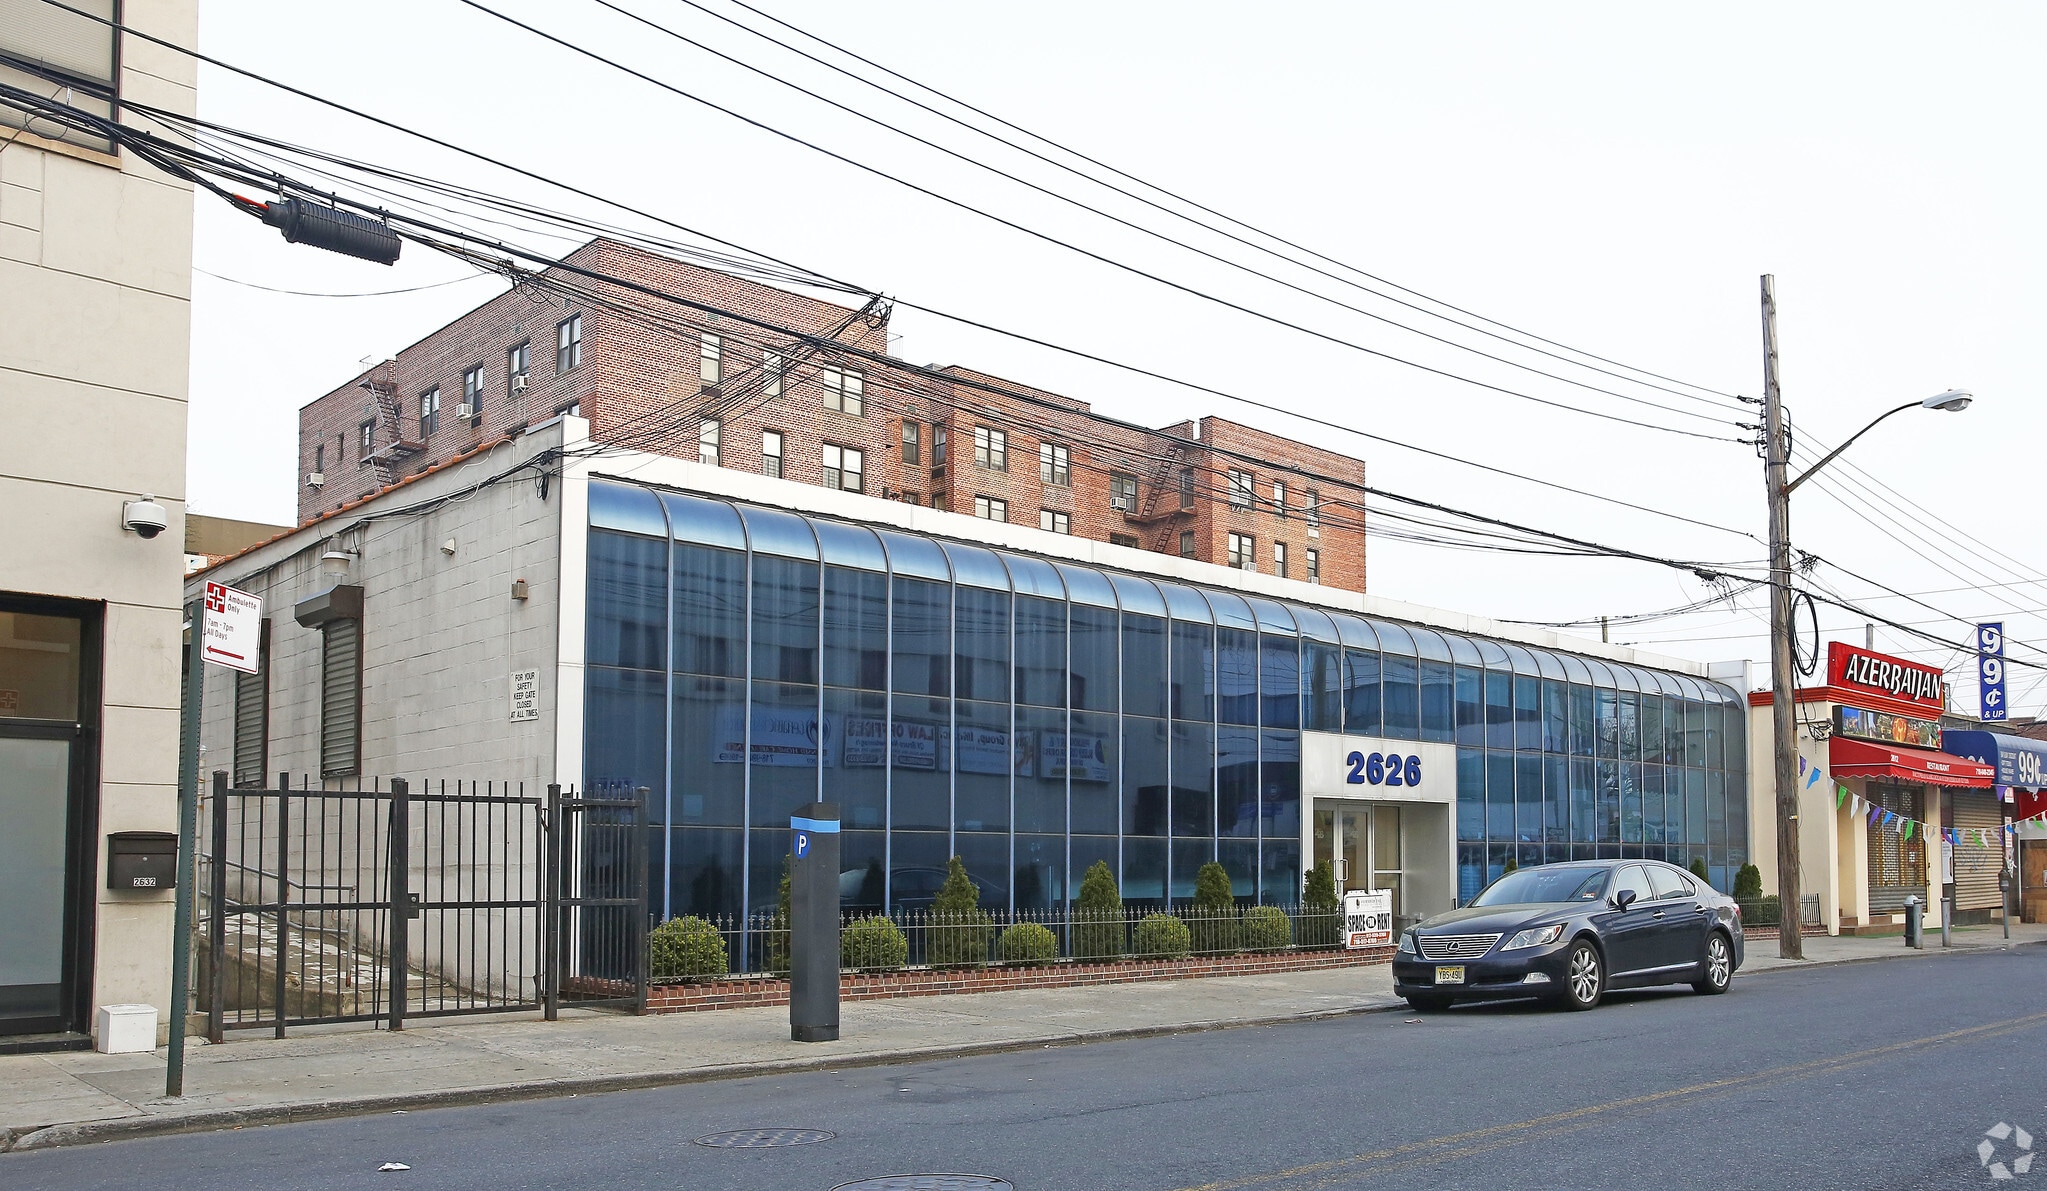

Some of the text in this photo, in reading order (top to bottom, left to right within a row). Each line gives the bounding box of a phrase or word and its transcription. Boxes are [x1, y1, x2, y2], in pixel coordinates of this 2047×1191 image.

[228, 595, 257, 610] Ambulette
[228, 603, 240, 615] Only
[208, 618, 219, 627] 7am
[222, 622, 234, 632] 7pm
[215, 629, 228, 640] Days
[515, 673, 523, 681] FOR
[1844, 653, 1943, 701] AZERBAIJAN
[517, 681, 532, 690] SAFETY
[1984, 709, 2004, 718] & UP
[1347, 751, 1422, 787] 2626
[2018, 750, 2041, 785] 99¢
[798, 834, 807, 855] P
[133, 877, 156, 887] 2632
[1347, 914, 1366, 933] SPACE
[1376, 912, 1390, 931] RENT
